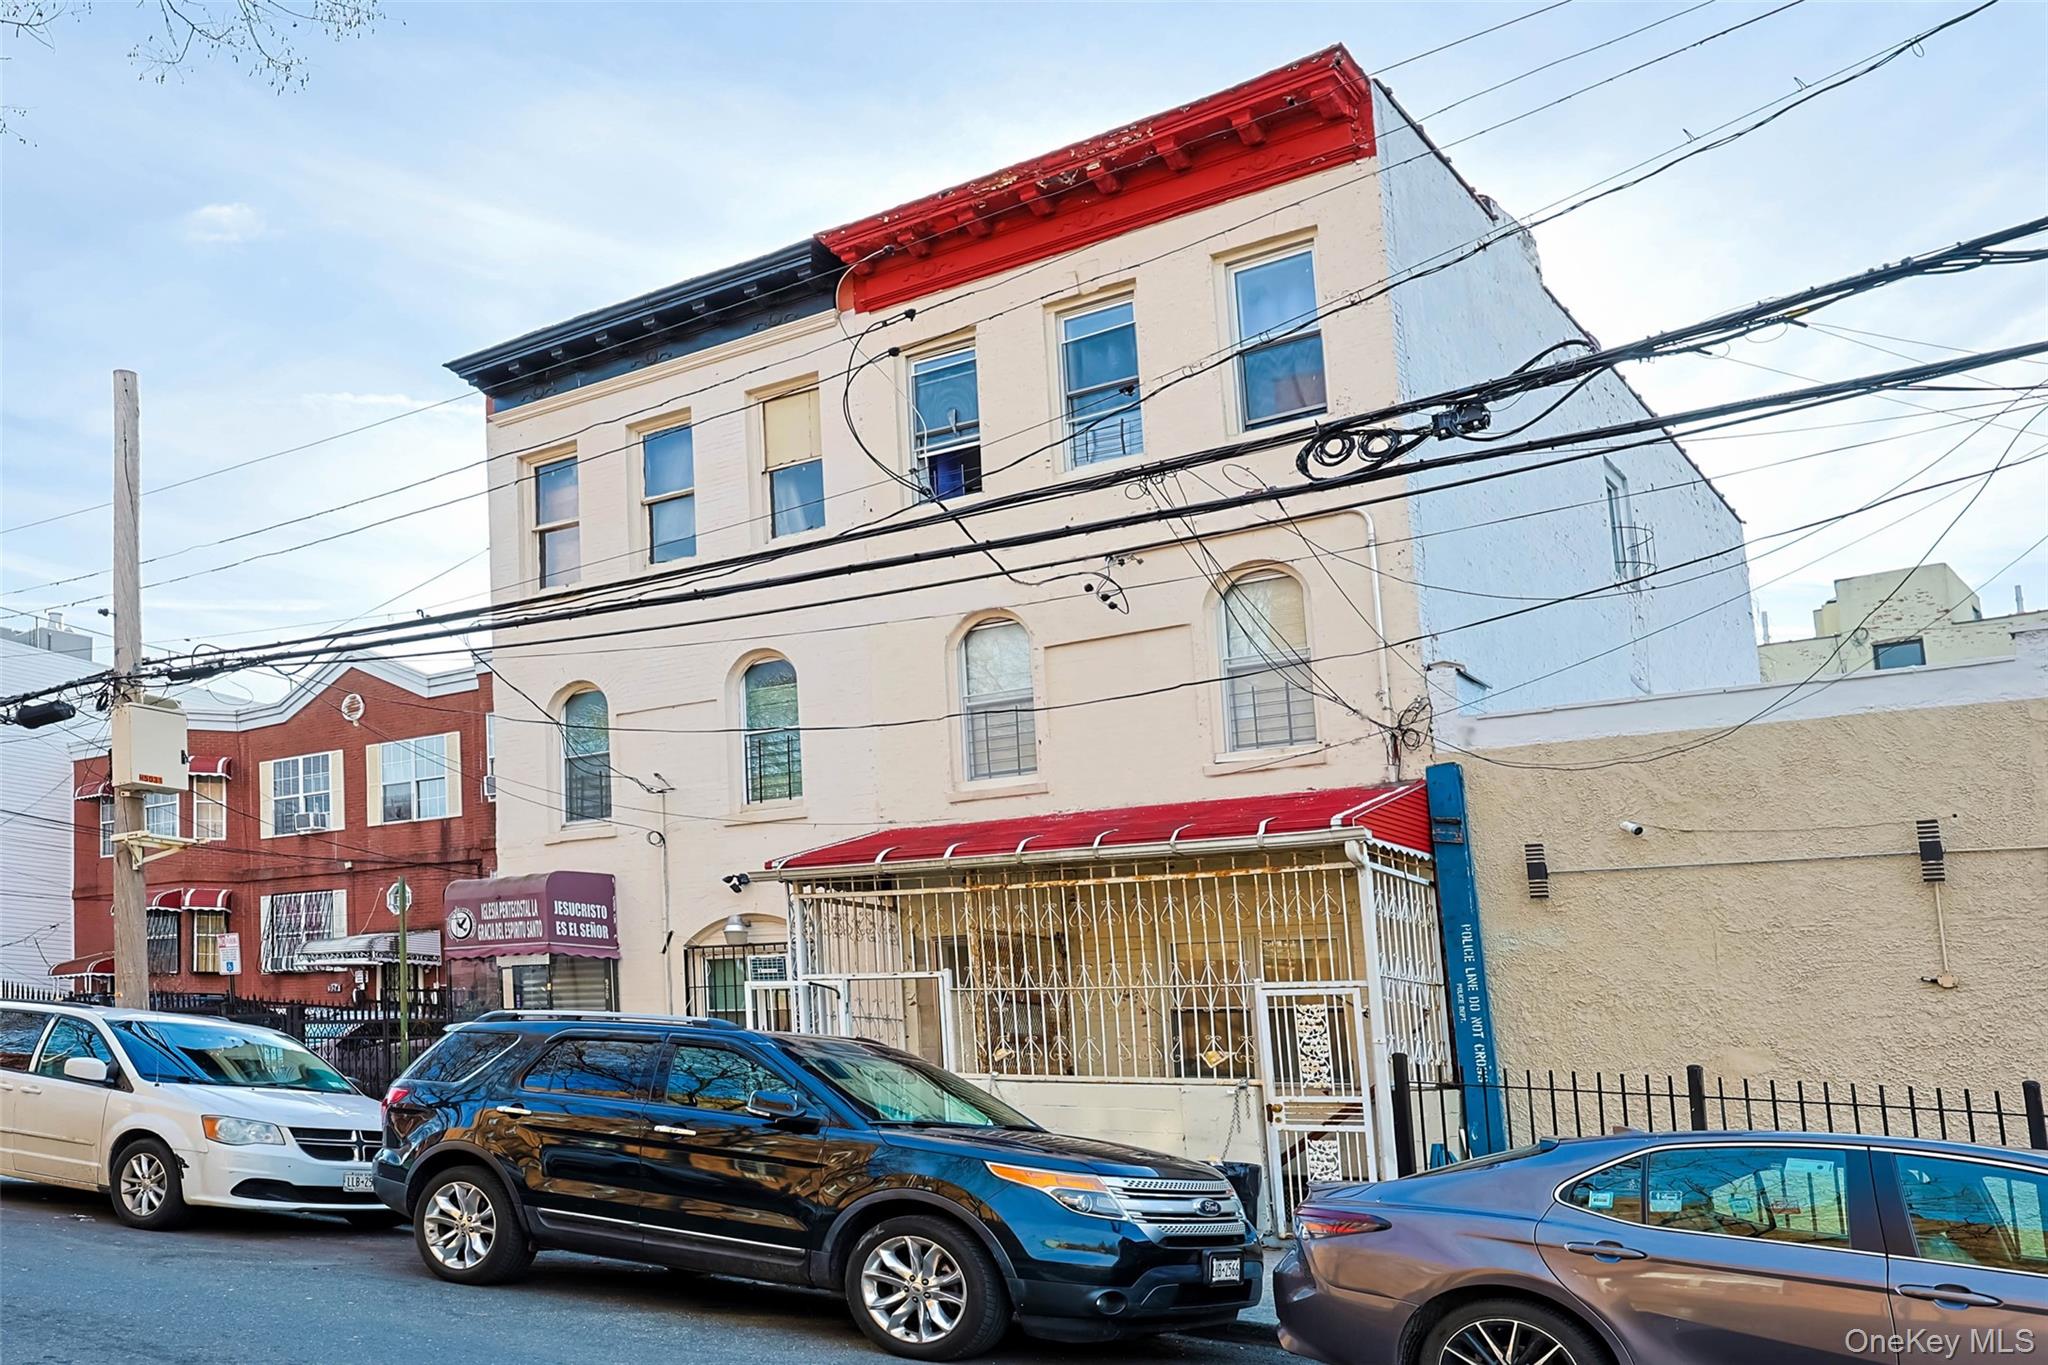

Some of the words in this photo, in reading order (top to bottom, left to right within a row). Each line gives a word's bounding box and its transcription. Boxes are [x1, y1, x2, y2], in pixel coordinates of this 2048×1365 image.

[480, 901, 499, 920] IGLESIA
[499, 898, 531, 919] PENTECOSTAL
[531, 898, 539, 917] LA
[554, 900, 608, 920] JESUCRISTO
[477, 923, 495, 941] GRACIA
[495, 921, 505, 940] DEL
[504, 920, 526, 939] ESPIRITU
[526, 919, 543, 938] SANTO
[555, 921, 568, 936] ES
[568, 922, 579, 937] EL
[579, 921, 609, 939] SEÑOR
[1461, 923, 1475, 963] POLICE
[1465, 967, 1478, 991] LINE
[1456, 983, 1465, 1004] POLICE
[1469, 996, 1481, 1012] DO
[1471, 1016, 1485, 1039] NOT
[1204, 1200, 1218, 1212] Ford
